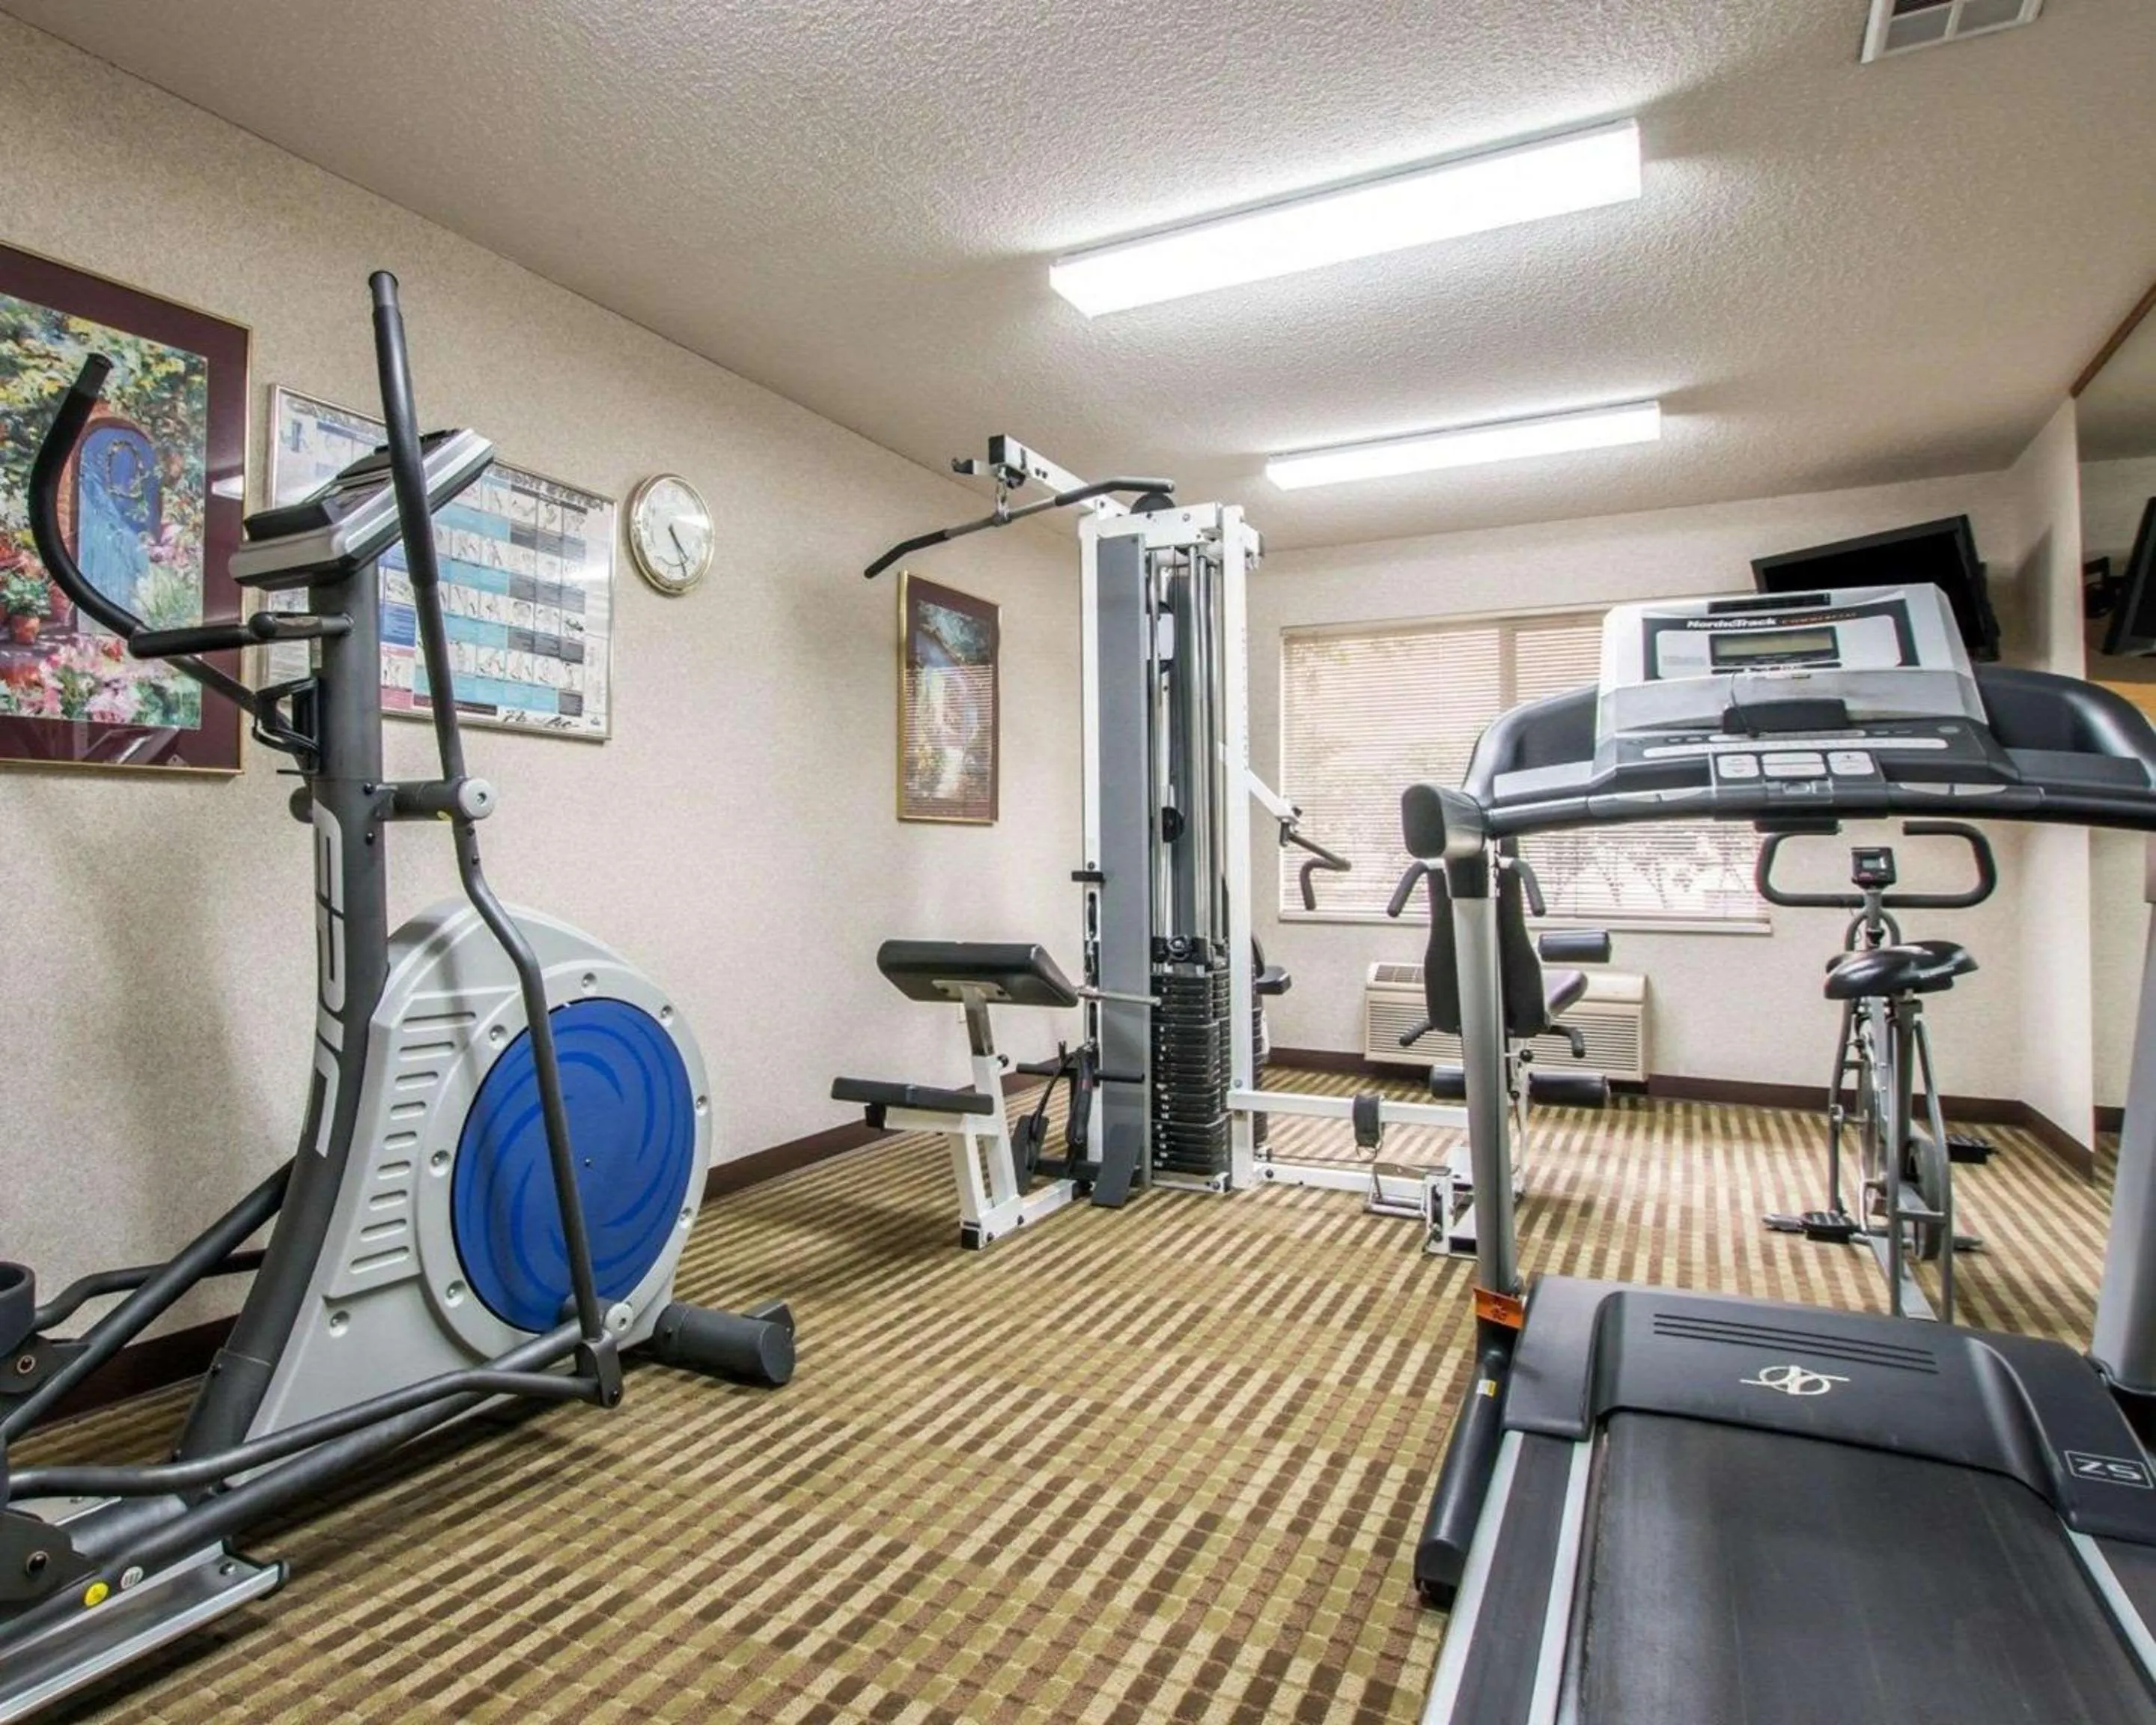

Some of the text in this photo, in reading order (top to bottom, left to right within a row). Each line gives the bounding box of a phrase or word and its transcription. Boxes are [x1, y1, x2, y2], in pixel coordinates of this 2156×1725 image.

[1686, 616, 1777, 629] NordicTrack
[302, 798, 345, 1158] EPIC
[2074, 1457, 2142, 1480] ZS
